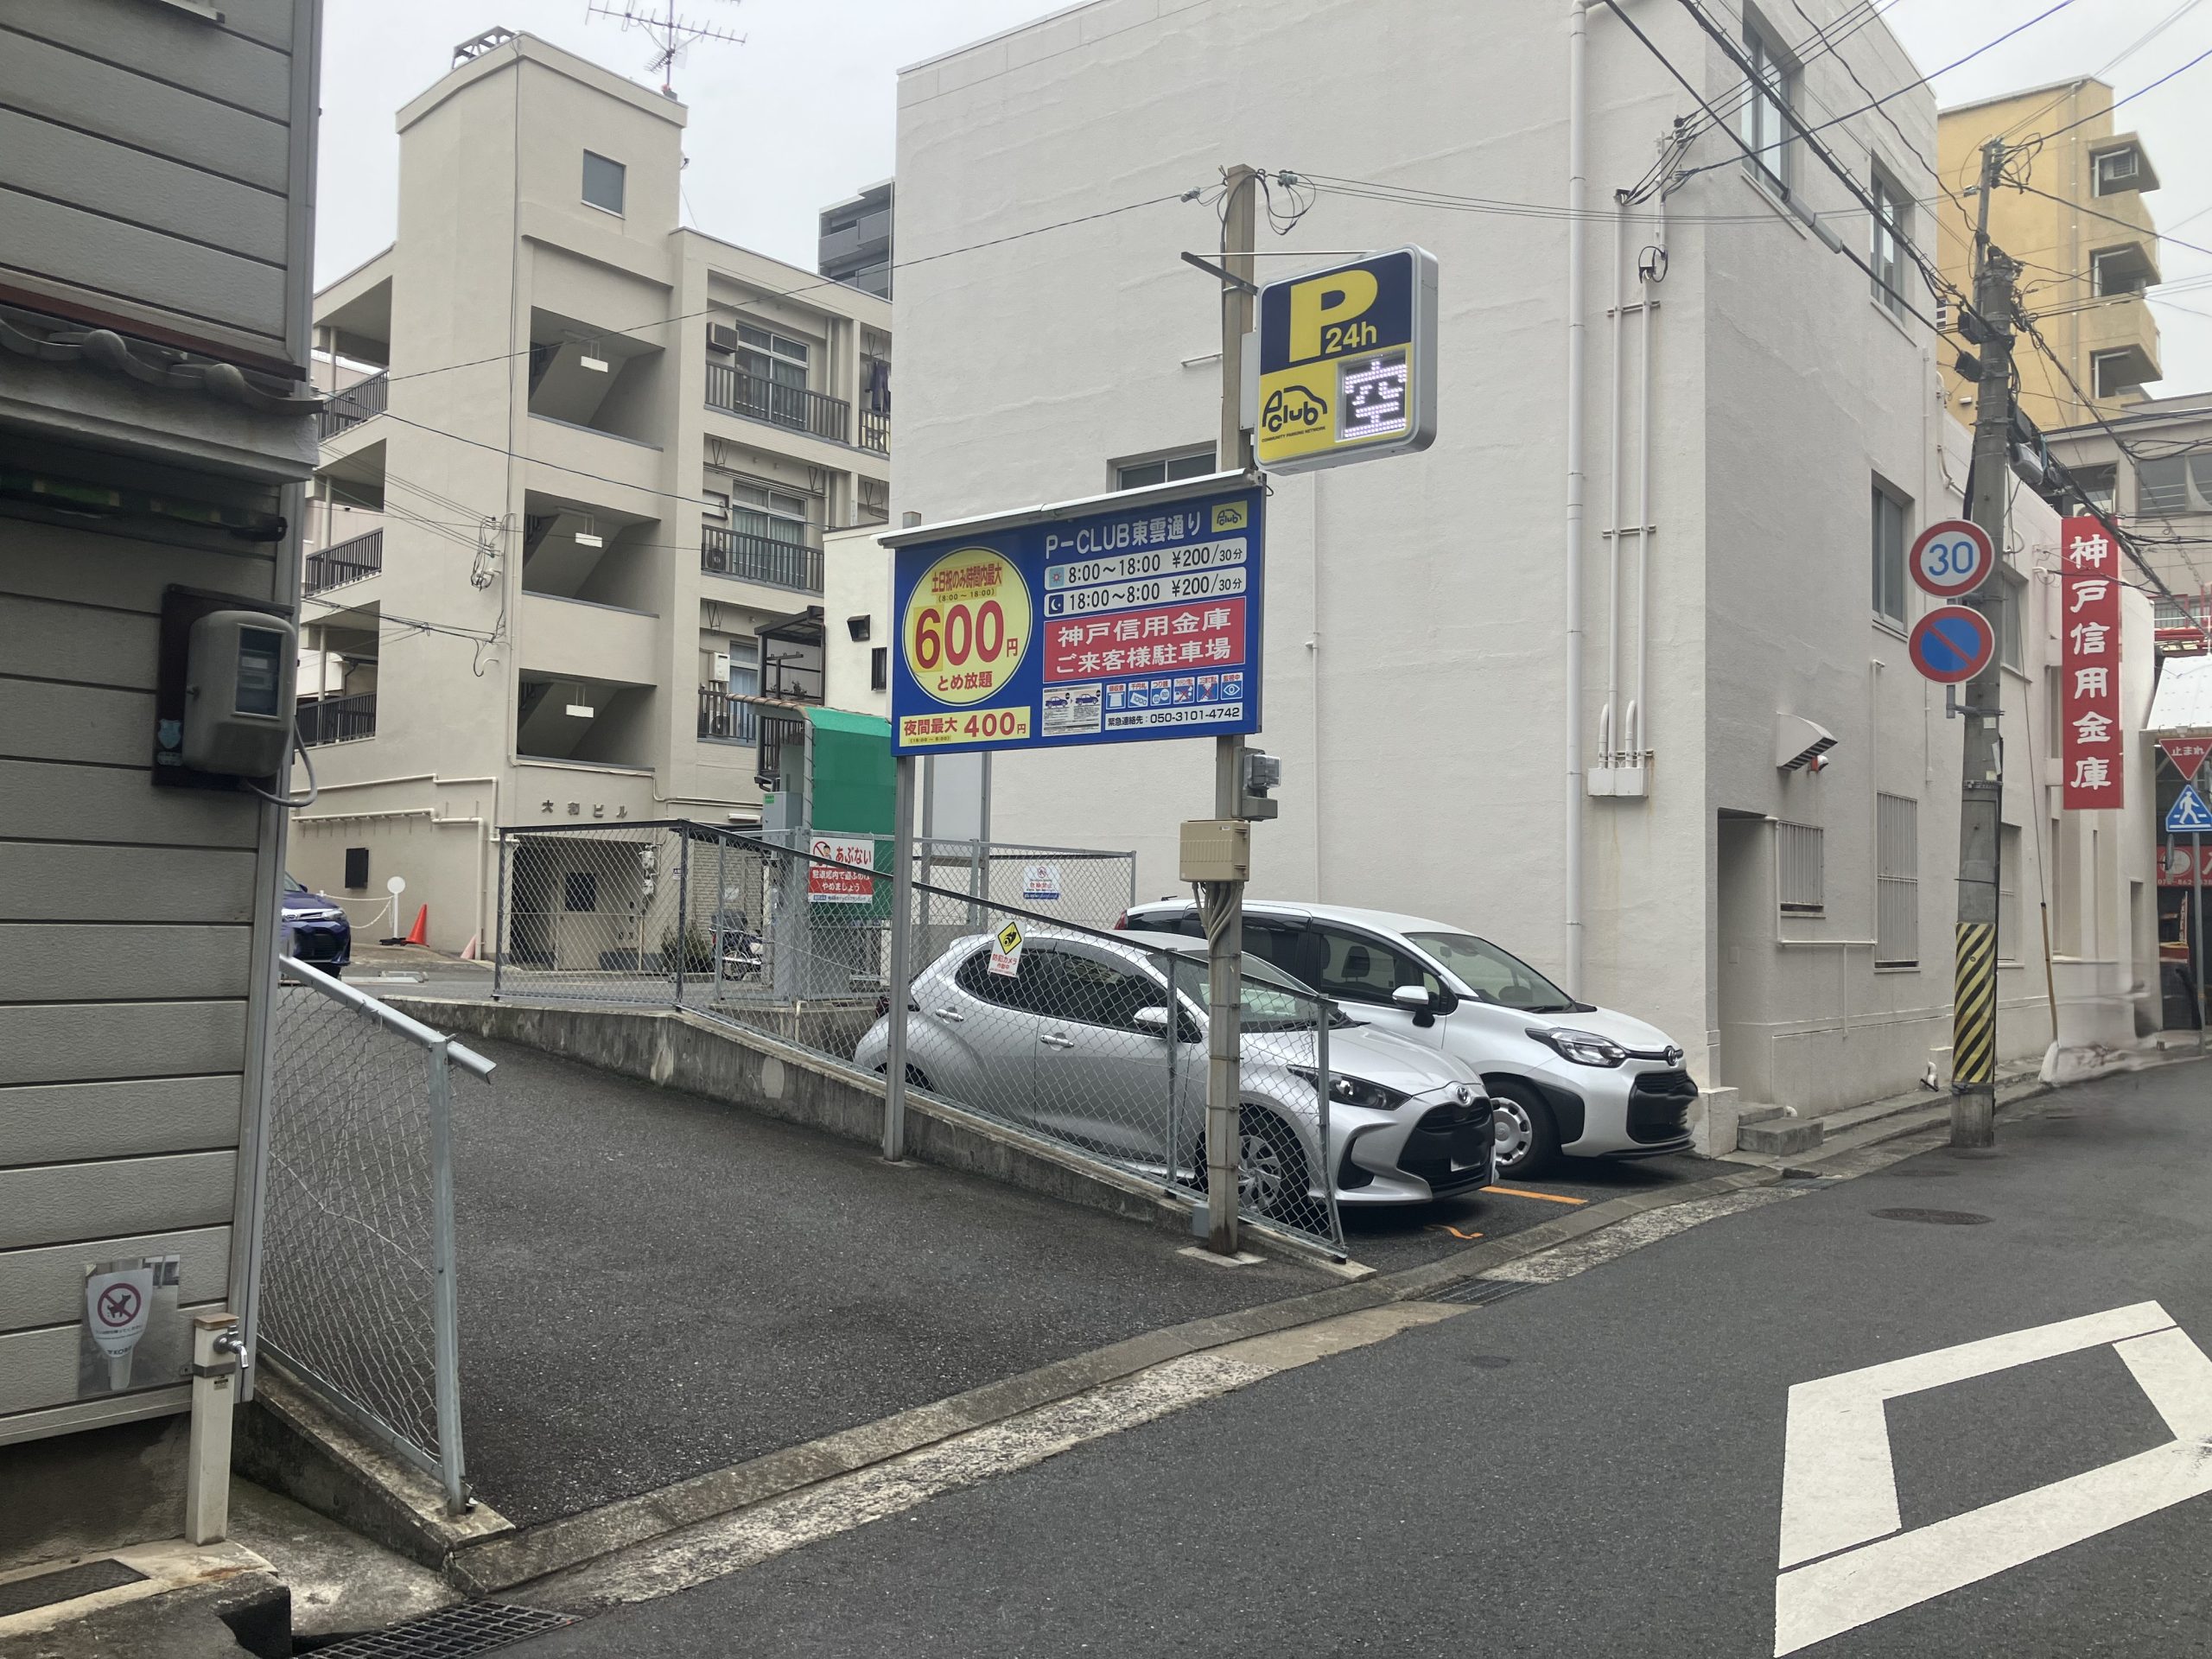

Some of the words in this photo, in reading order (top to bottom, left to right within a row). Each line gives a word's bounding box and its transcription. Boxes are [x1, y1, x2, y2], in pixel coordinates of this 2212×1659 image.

[1289, 270, 1378, 363] P
[1325, 321, 1377, 354] 24h
[1344, 360, 1407, 438] 空
[1929, 541, 1974, 576] 30
[931, 563, 1002, 594] 土日祝のみ時間内最大
[1058, 607, 1231, 648] 神戸信用金庫
[1057, 637, 1231, 673] ご来客様駐車場
[2069, 533, 2113, 791] 神戸信用金庫
[938, 671, 992, 691] とめ放題
[1134, 695, 1147, 706] 1000
[904, 716, 958, 736] 夜間最大
[2171, 745, 2205, 756] 止まれ
[836, 846, 872, 865] あぶない
[822, 882, 860, 893] やめましょう
[992, 953, 1018, 965] 防犯カメラ
